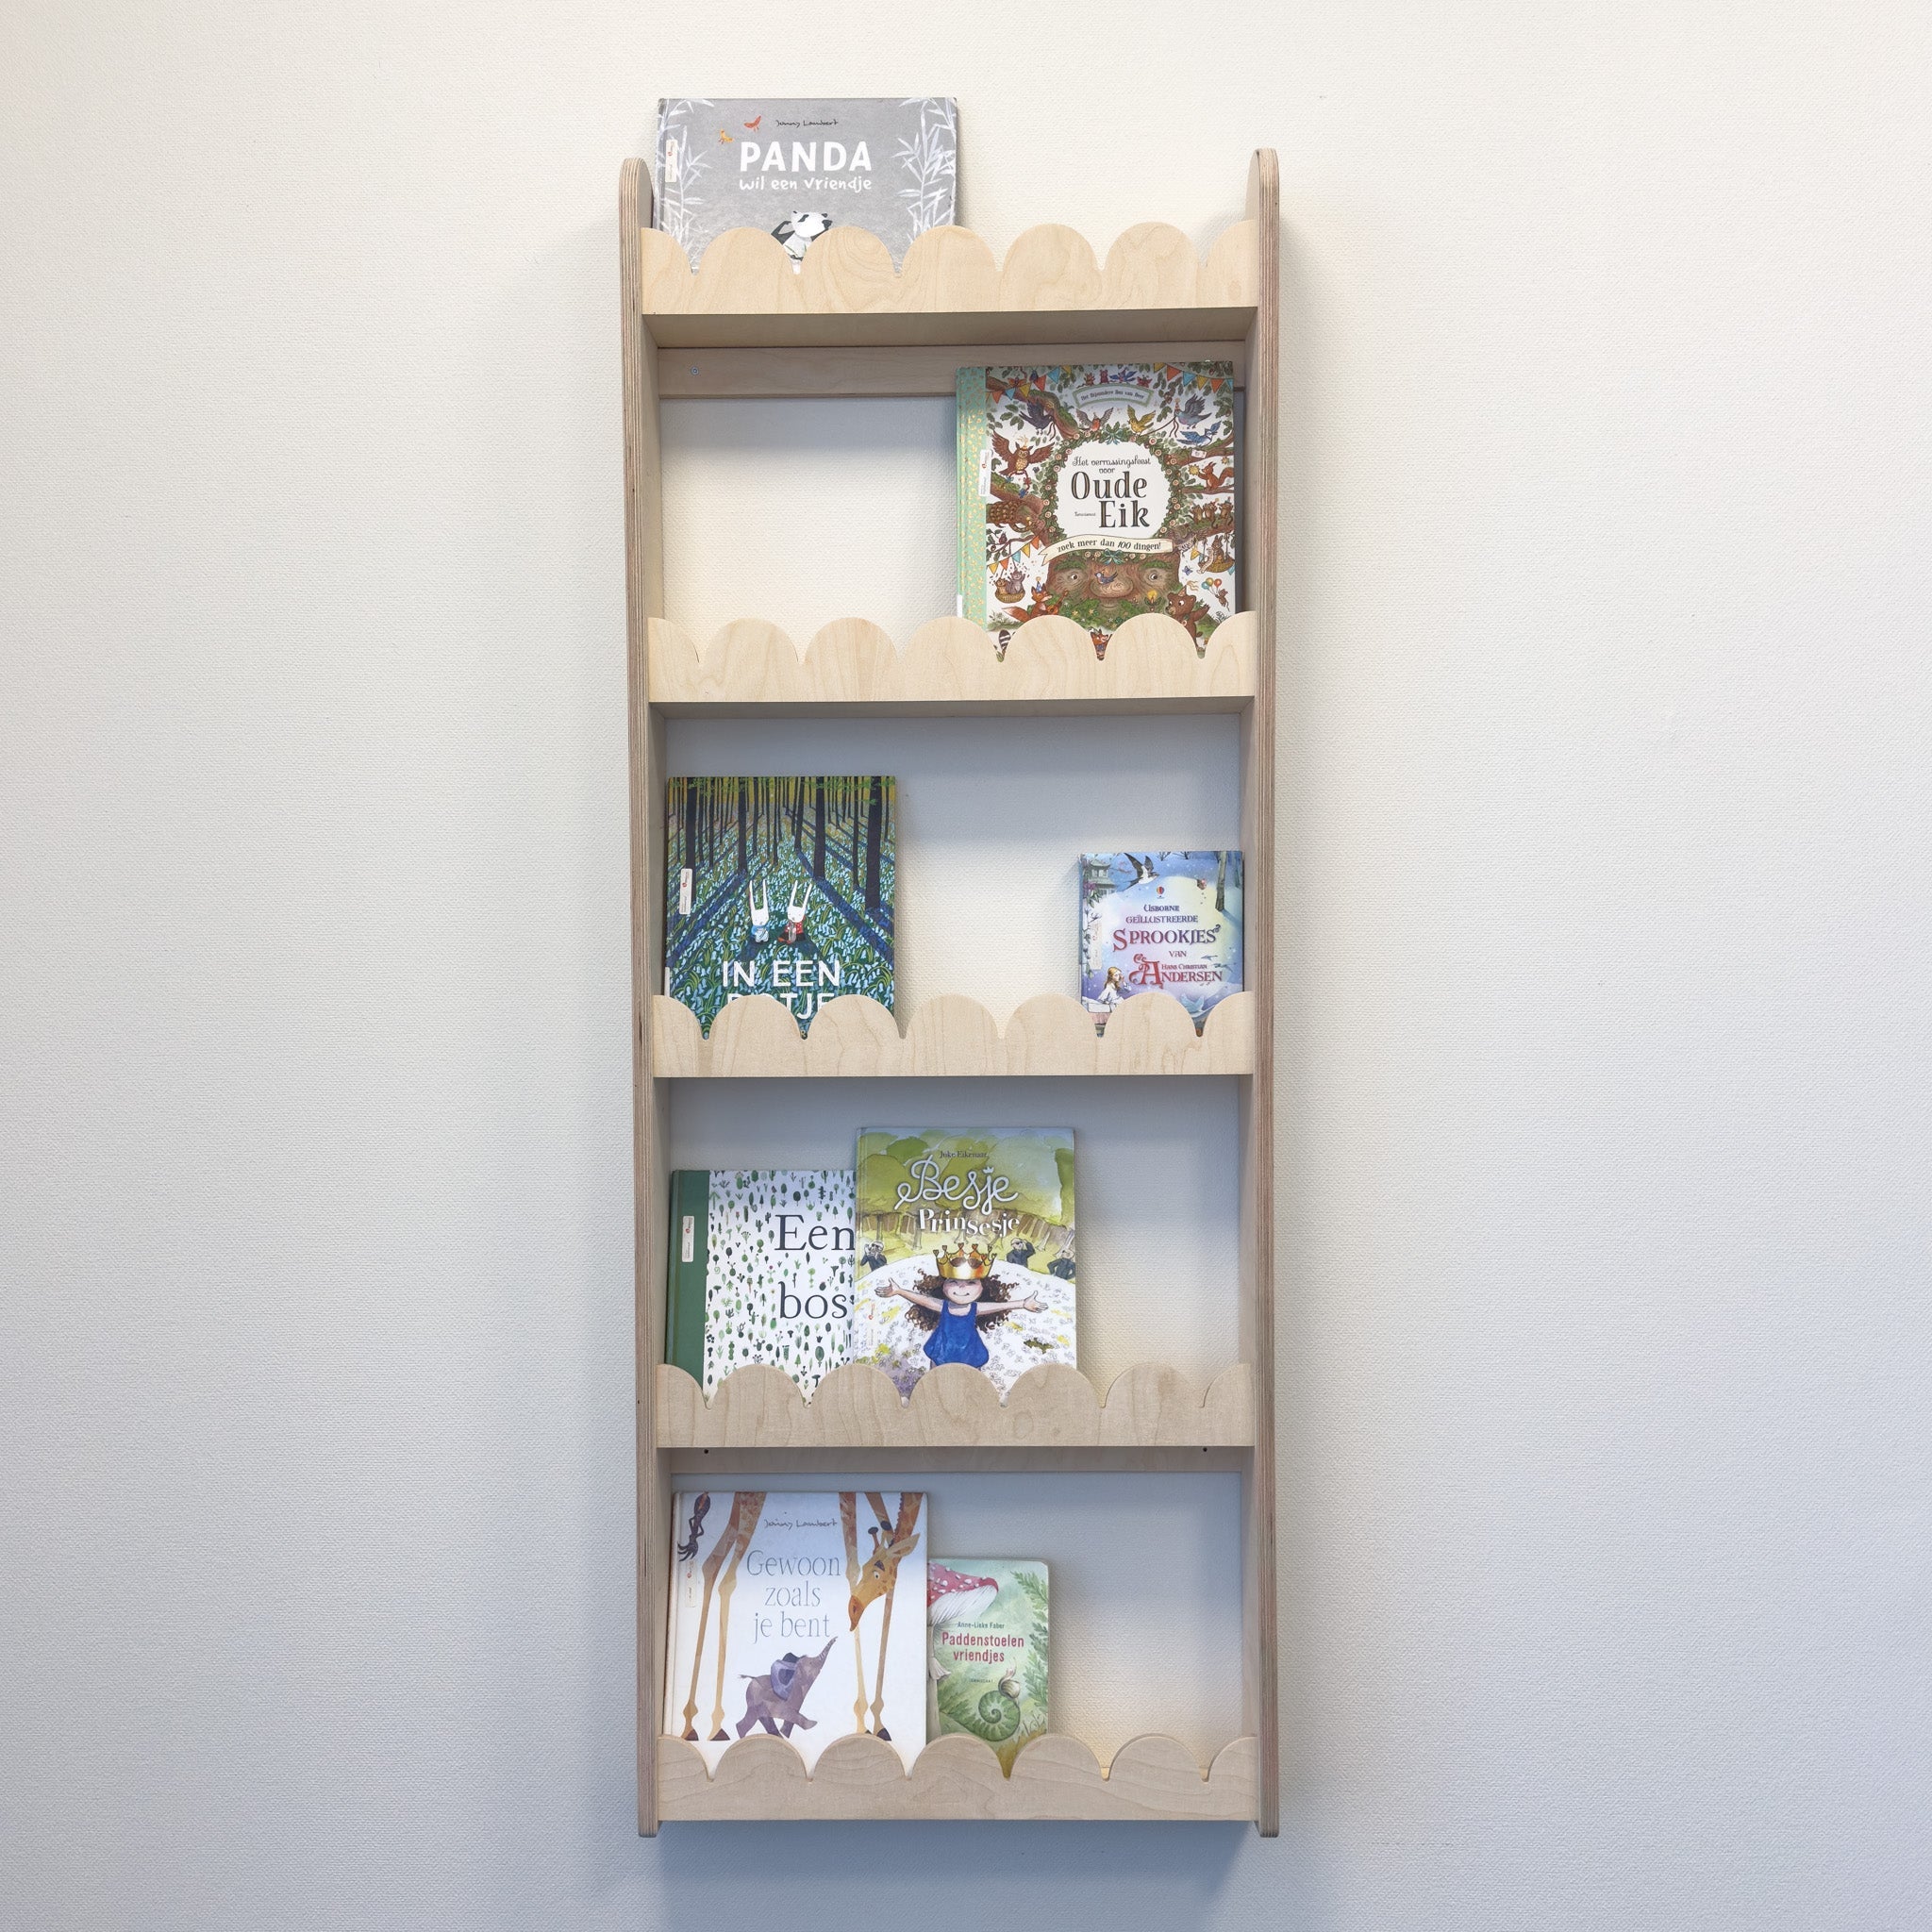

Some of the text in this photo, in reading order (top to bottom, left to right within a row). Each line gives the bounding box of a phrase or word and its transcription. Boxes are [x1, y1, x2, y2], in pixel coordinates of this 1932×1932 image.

[803, 119, 839, 127] Lambert
[740, 141, 872, 173] PANDA
[739, 175, 872, 193] wil een vriendje
[1072, 455, 1152, 468] Het verrassingsfeest
[1071, 471, 1148, 500] Oude
[1098, 499, 1151, 528] Eik
[1057, 538, 1161, 553] zoek meer dan 100 dingen!
[1112, 924, 1222, 953] SPROOKJES
[723, 959, 841, 987] IN EEN
[1128, 953, 1224, 989] ANDERSEN
[893, 1154, 1019, 1216] Besje
[774, 1213, 856, 1251] Een
[918, 1208, 1021, 1238] Prinsesje
[778, 1280, 848, 1319] bos
[795, 1518, 838, 1527] Lambert
[746, 1549, 841, 1576] Gewoon
[764, 1580, 821, 1607] zoals
[753, 1610, 830, 1644] je bent
[941, 1631, 1025, 1648] Paddenstoelen
[989, 1622, 1006, 1630] Faber
[953, 1648, 1006, 1665] vriendjes
